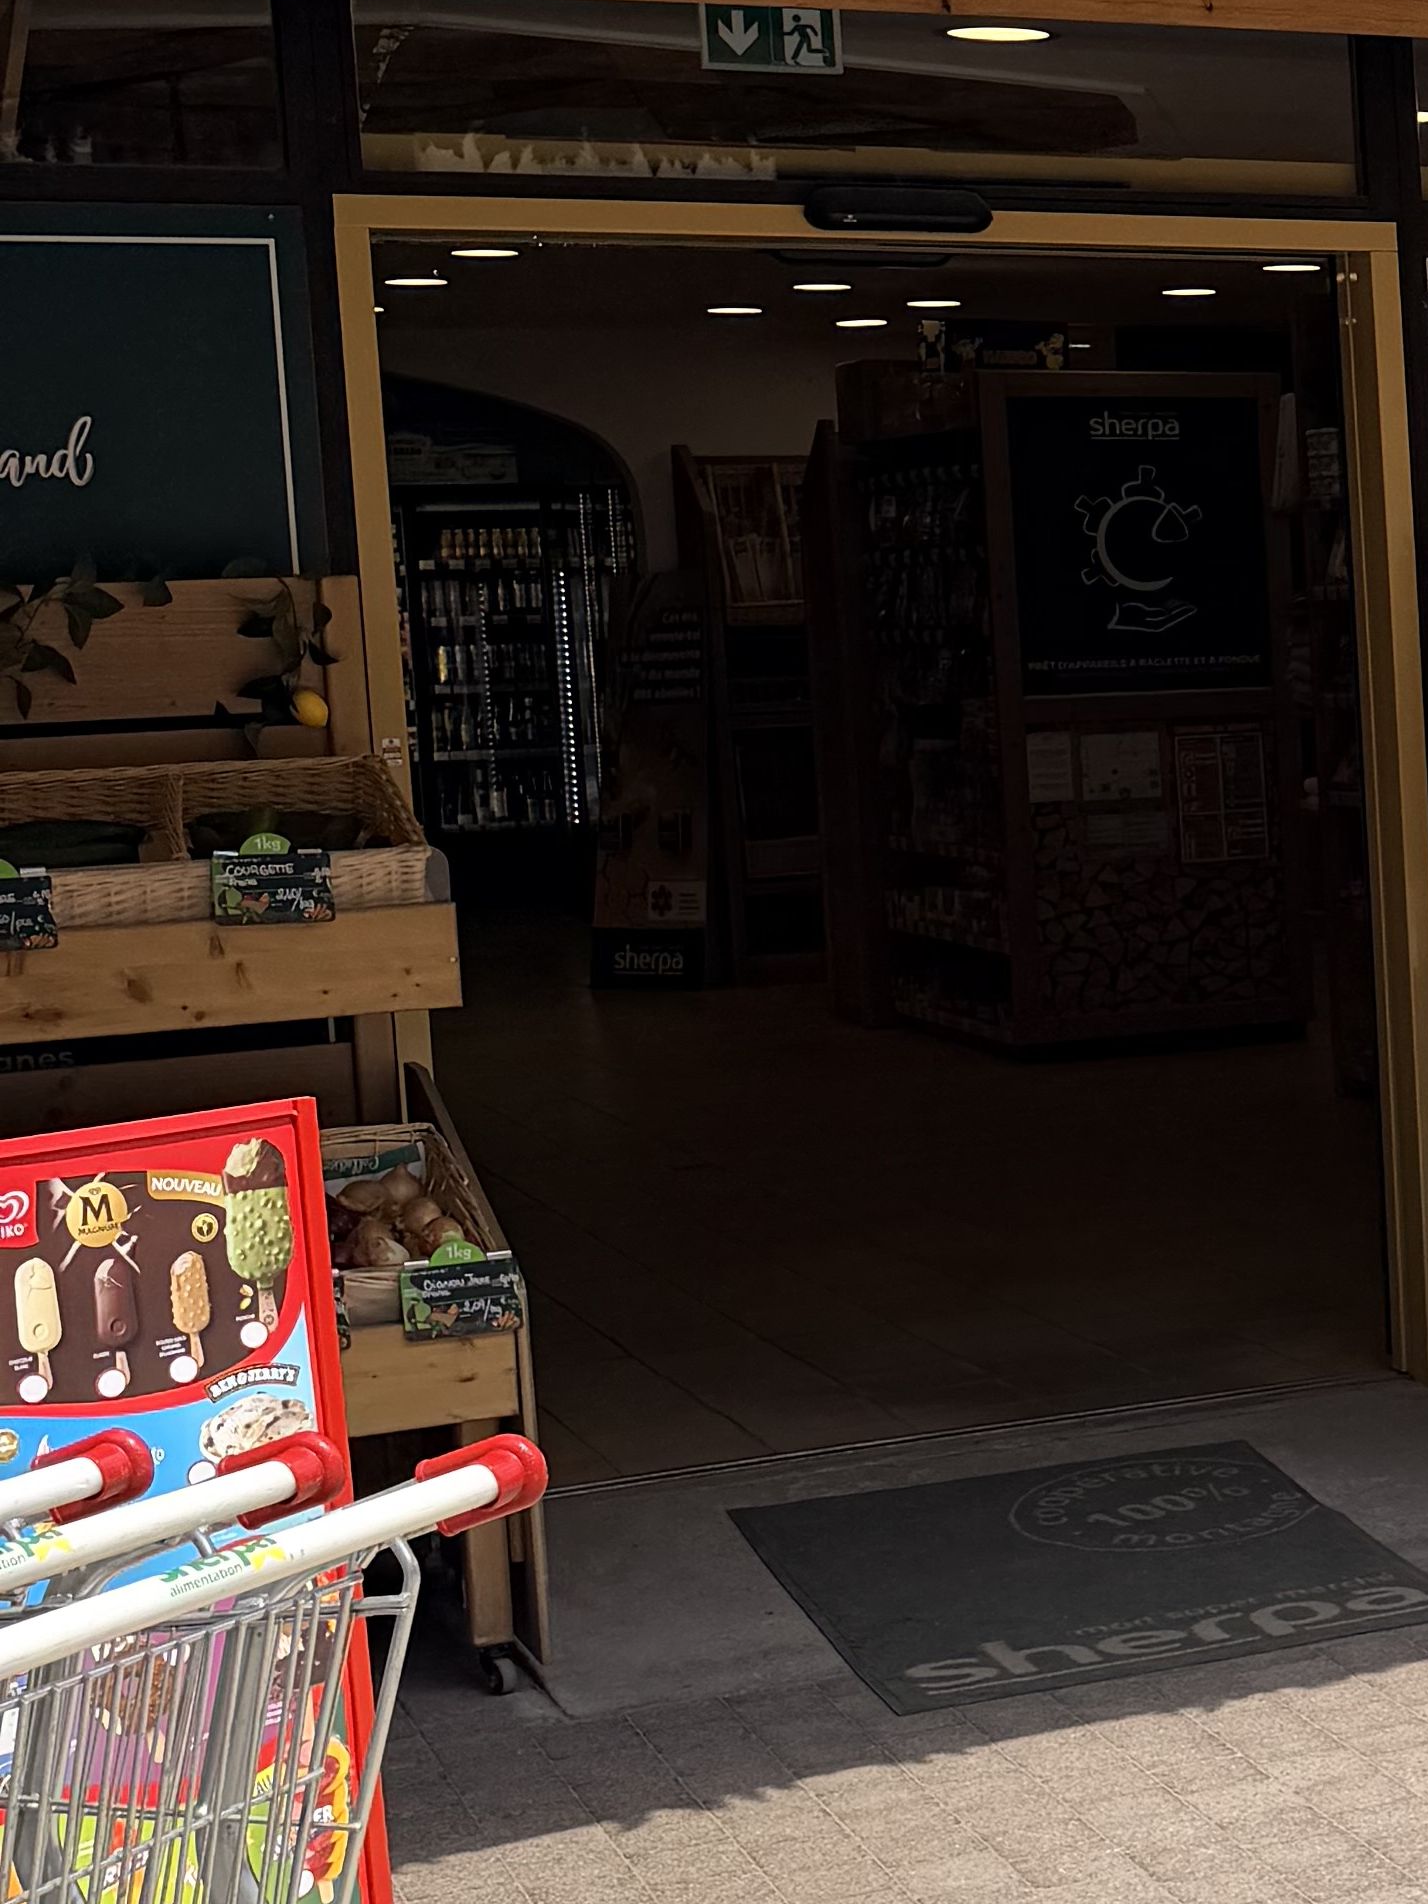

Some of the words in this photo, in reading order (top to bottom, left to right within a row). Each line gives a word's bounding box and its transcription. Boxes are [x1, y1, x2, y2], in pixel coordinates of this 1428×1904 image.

[1087, 409, 1182, 440] sherpa
[255, 838, 281, 852] 1kg
[225, 862, 295, 877] COURGETTE
[613, 943, 685, 975] sherpa
[151, 1176, 222, 1197] NOUVEAU
[77, 1222, 121, 1236] MAGNUM
[446, 1244, 472, 1260] 1kg
[1086, 1483, 1250, 1527] 100%
[170, 1563, 243, 1598] alimentation
